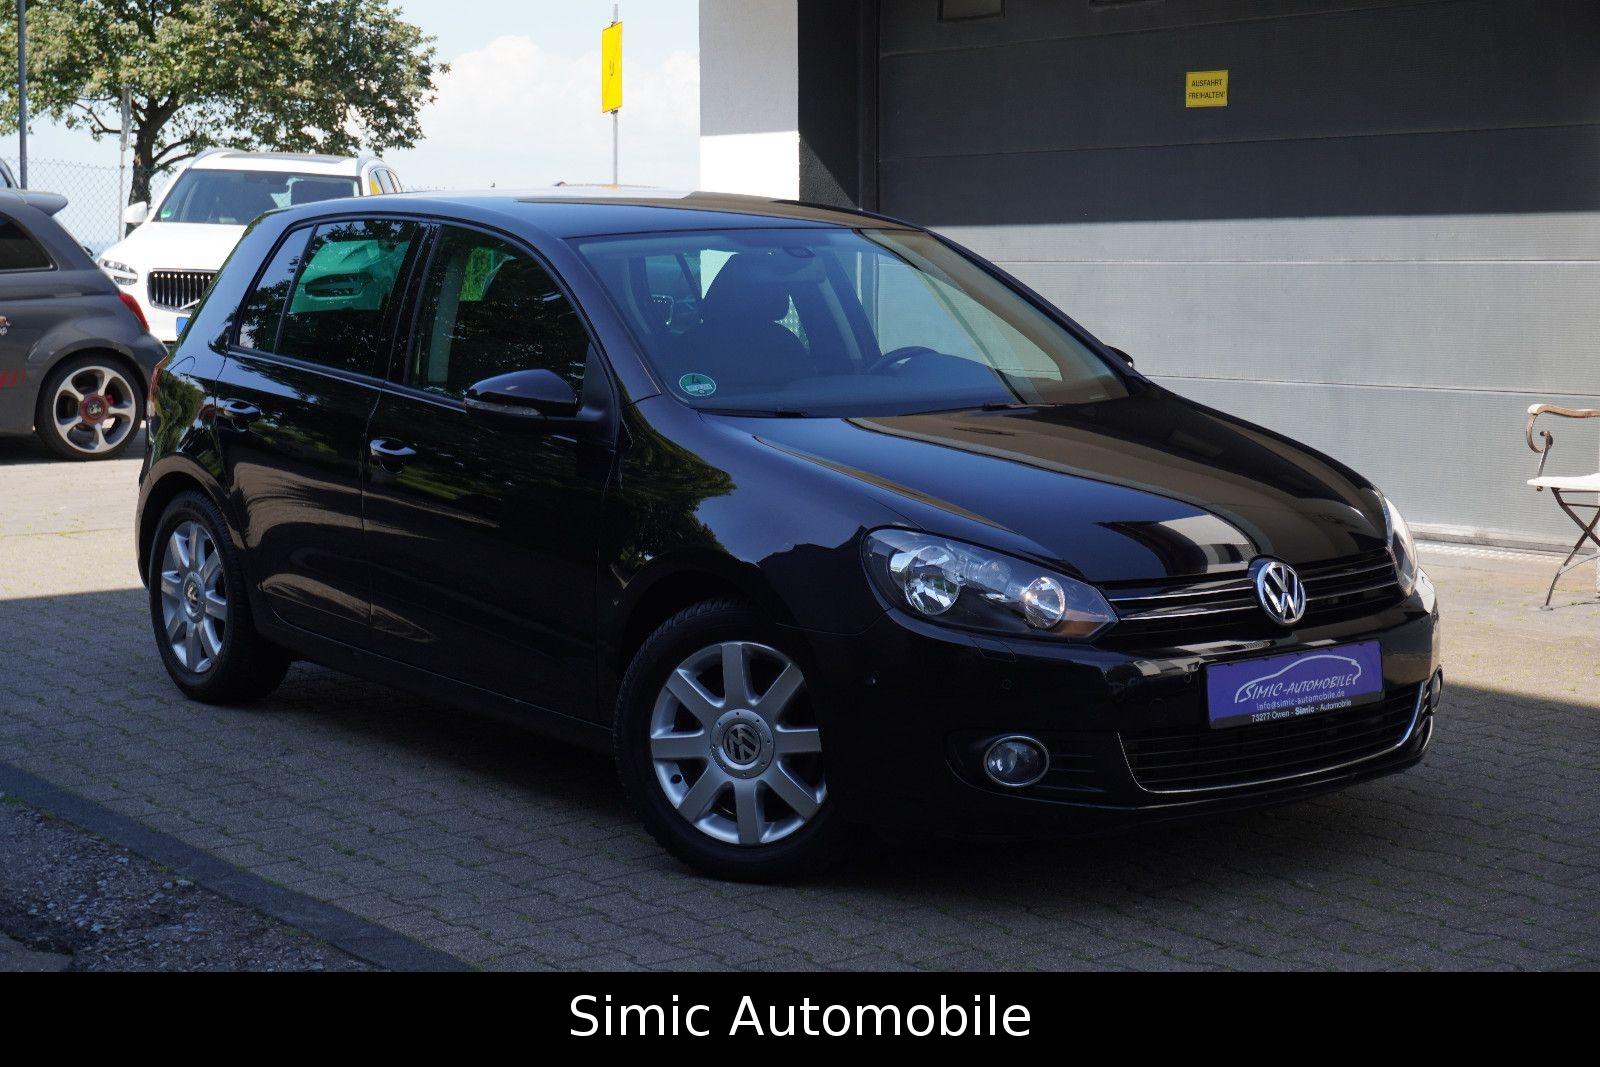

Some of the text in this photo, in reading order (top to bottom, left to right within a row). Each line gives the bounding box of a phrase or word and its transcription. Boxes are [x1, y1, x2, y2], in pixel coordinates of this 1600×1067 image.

[1192, 79, 1222, 87] AUSFAHRT
[1238, 674, 1353, 703] SIMIC-AUTOMOBILE
[1251, 713, 1271, 723] 73277
[1271, 710, 1290, 720] Owen
[1295, 706, 1315, 715] Simic
[1320, 699, 1352, 711] Automobile
[1256, 690, 1345, 711] info@simic-automobile.de
